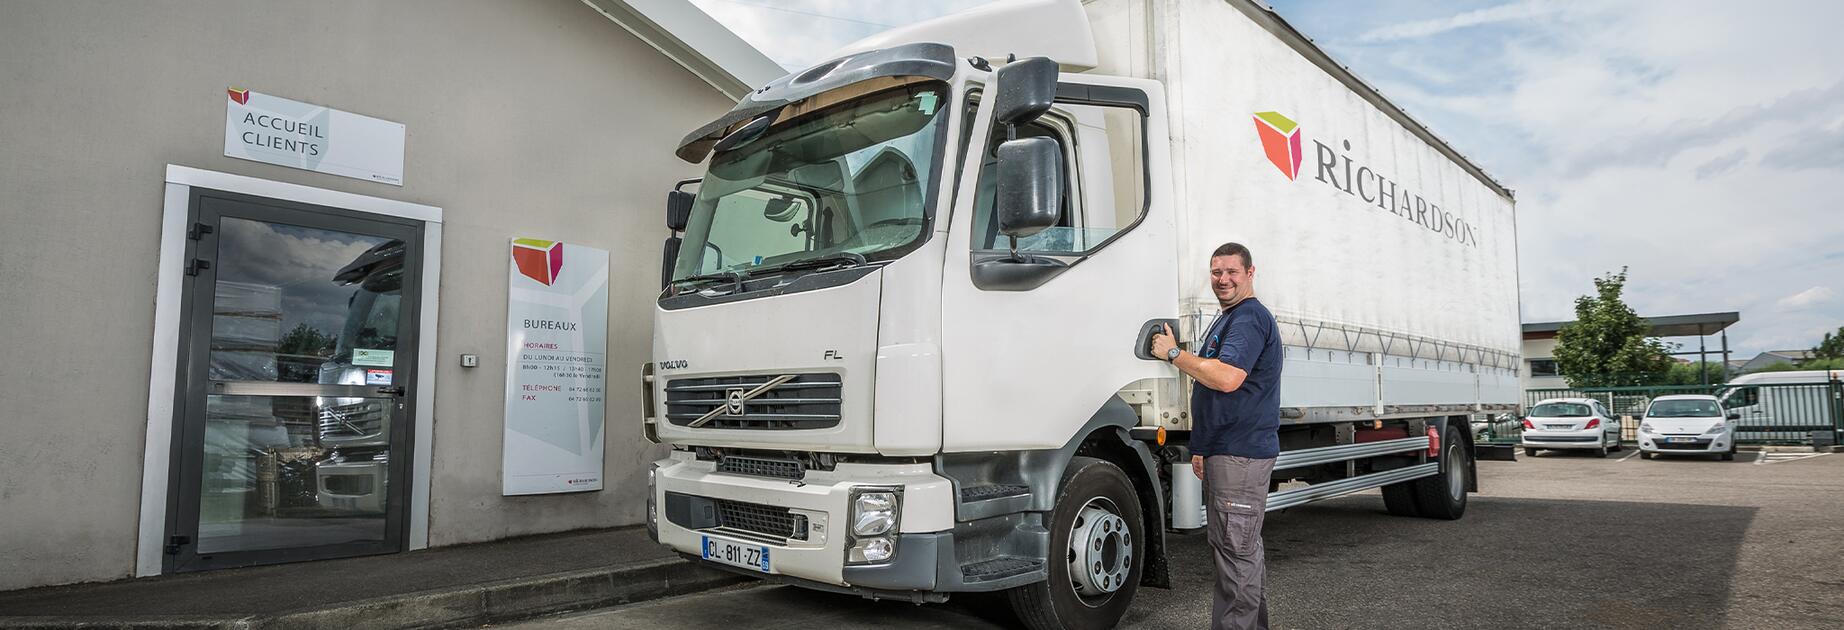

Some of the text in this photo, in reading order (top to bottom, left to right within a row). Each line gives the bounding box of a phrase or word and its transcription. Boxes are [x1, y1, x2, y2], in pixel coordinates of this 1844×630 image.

[244, 112, 324, 138] ACCUEIL
[242, 131, 319, 156] CLIENTS
[524, 319, 576, 331] BUREAUX
[523, 342, 558, 350] HORAIRES
[824, 350, 843, 360] FL
[660, 359, 688, 370] VOLVO
